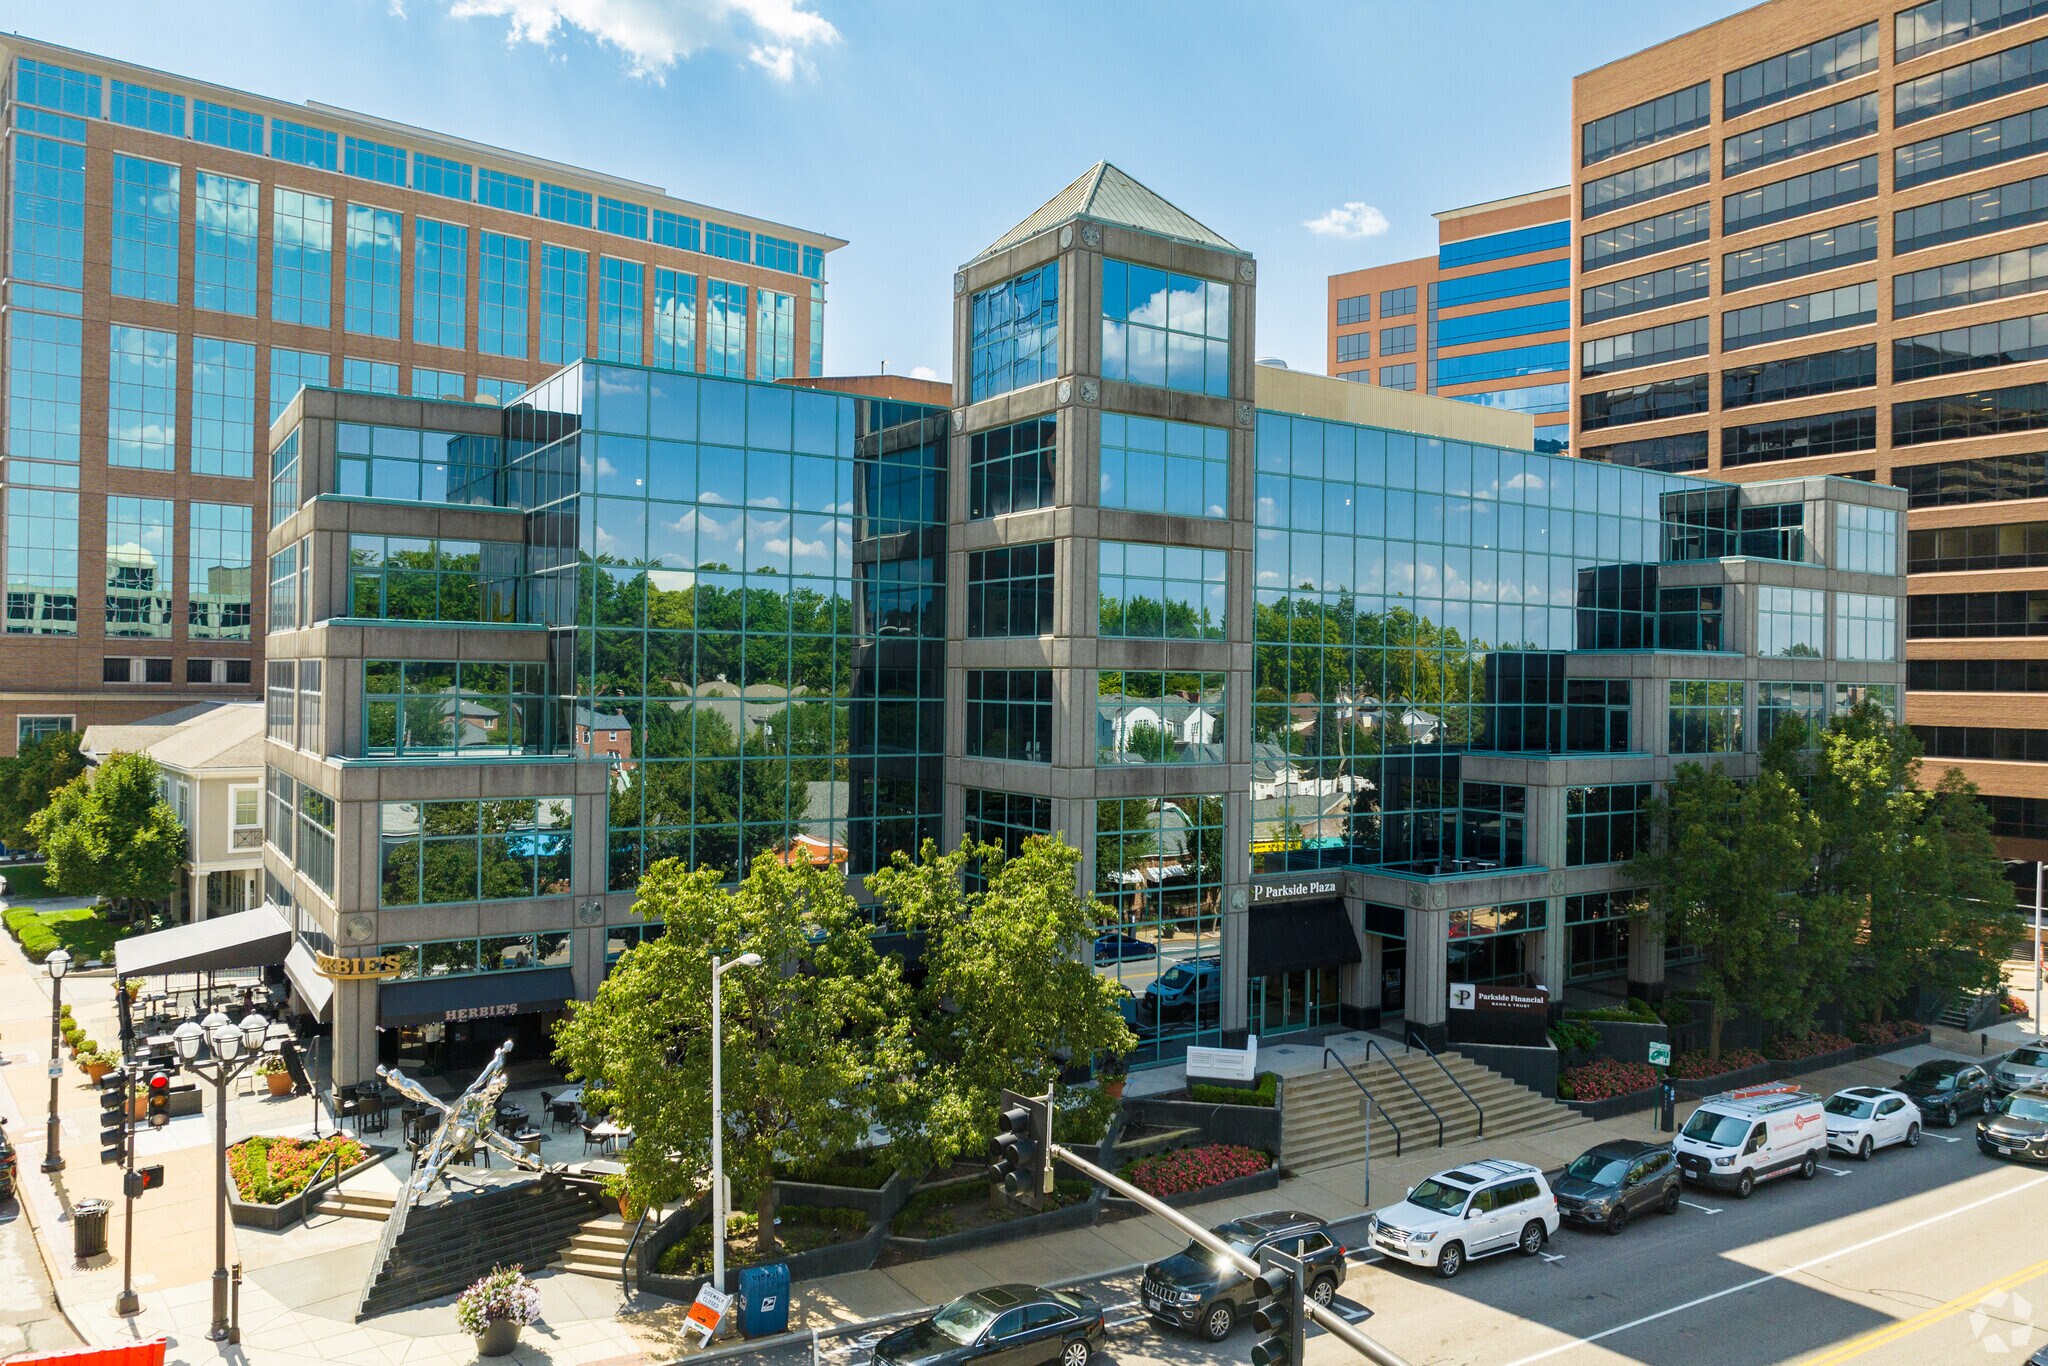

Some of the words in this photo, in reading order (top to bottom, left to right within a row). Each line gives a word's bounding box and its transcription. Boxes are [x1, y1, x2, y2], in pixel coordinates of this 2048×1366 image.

[1265, 883, 1308, 898] Parkside
[1309, 882, 1336, 894] Plaza
[316, 954, 401, 975] RBIE'S
[1478, 993, 1510, 1002] Parkside
[1510, 995, 1544, 1004] Financial
[445, 1003, 518, 1021] HERBIE'S
[702, 1296, 720, 1309] CLOSED
[703, 1289, 725, 1304] SIDEWALK
[693, 1306, 717, 1320] DETOUR
